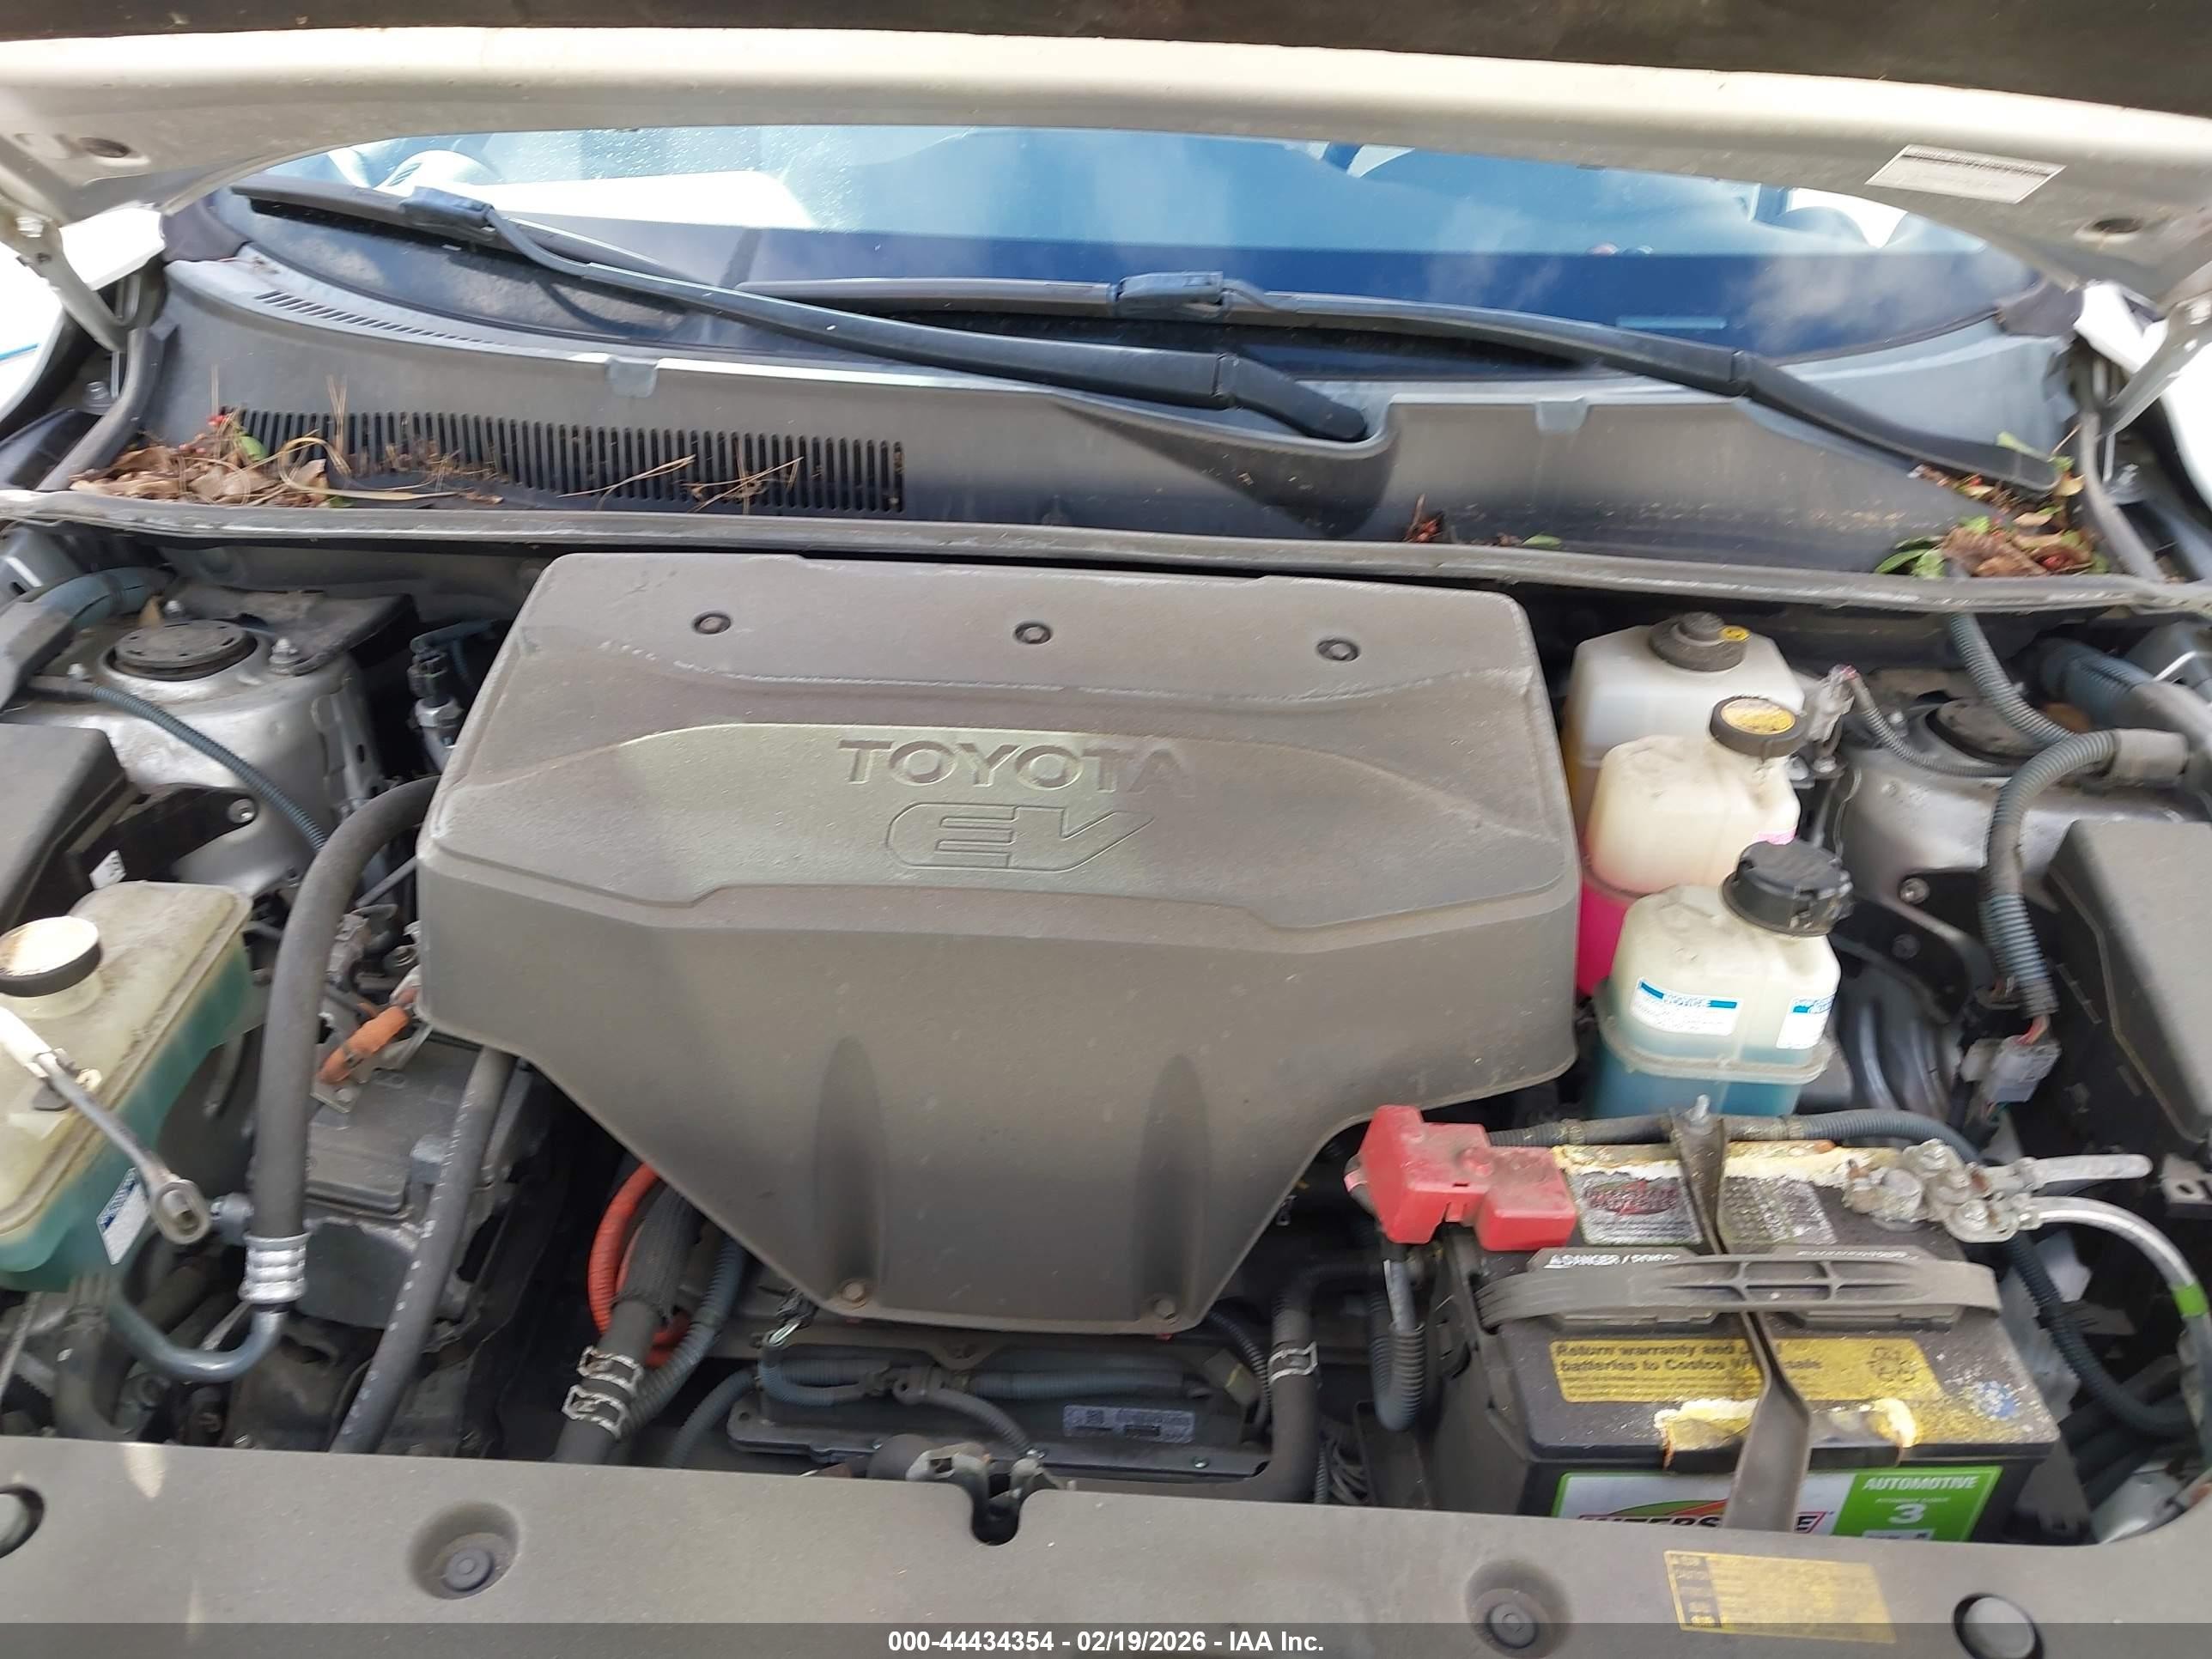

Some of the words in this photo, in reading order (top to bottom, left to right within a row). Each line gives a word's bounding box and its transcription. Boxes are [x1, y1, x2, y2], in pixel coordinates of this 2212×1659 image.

[838, 739, 1192, 797] TOYOTA
[885, 802, 1155, 873] EV
[1556, 1344, 1614, 1356] Return
[1620, 1345, 1695, 1358] warranty
[1702, 1343, 1735, 1355] and
[1559, 1359, 1636, 1371] batteries
[1642, 1359, 1659, 1371] to
[1665, 1358, 1725, 1371] Costco
[1862, 1475, 1980, 1491] AUTOMOTIVE
[1887, 1504, 1927, 1524] 3
